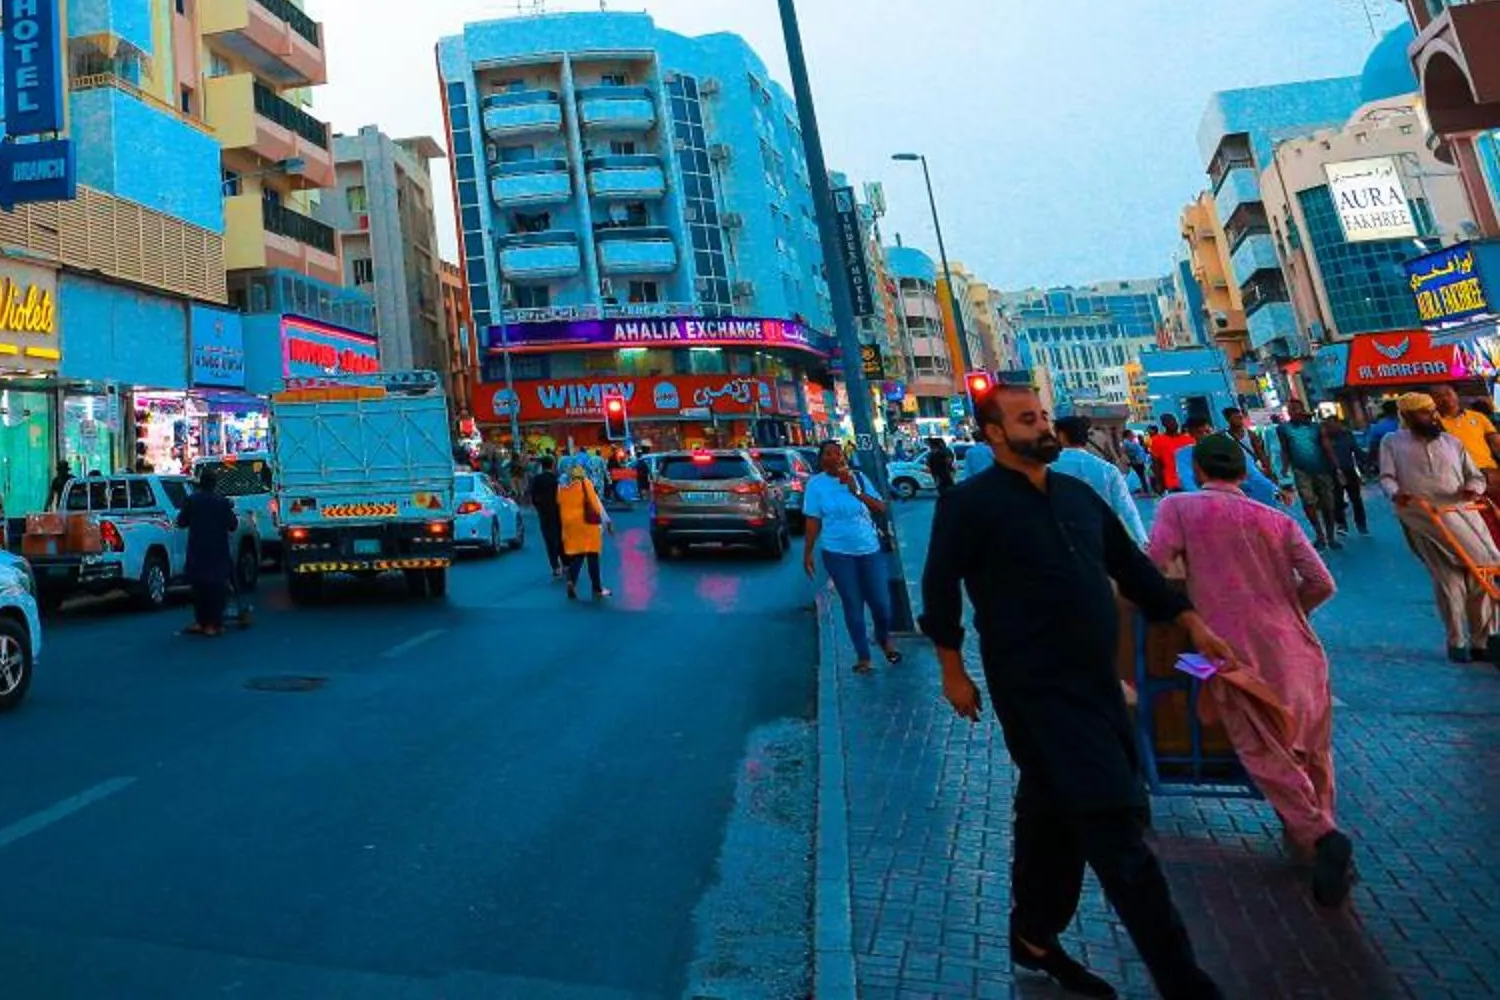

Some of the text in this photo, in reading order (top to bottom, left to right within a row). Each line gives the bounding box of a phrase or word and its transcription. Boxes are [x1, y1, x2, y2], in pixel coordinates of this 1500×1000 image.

[1341, 186, 1404, 211] AURA
[614, 322, 680, 340] AHALIA
[685, 321, 763, 339] EXCHANGE
